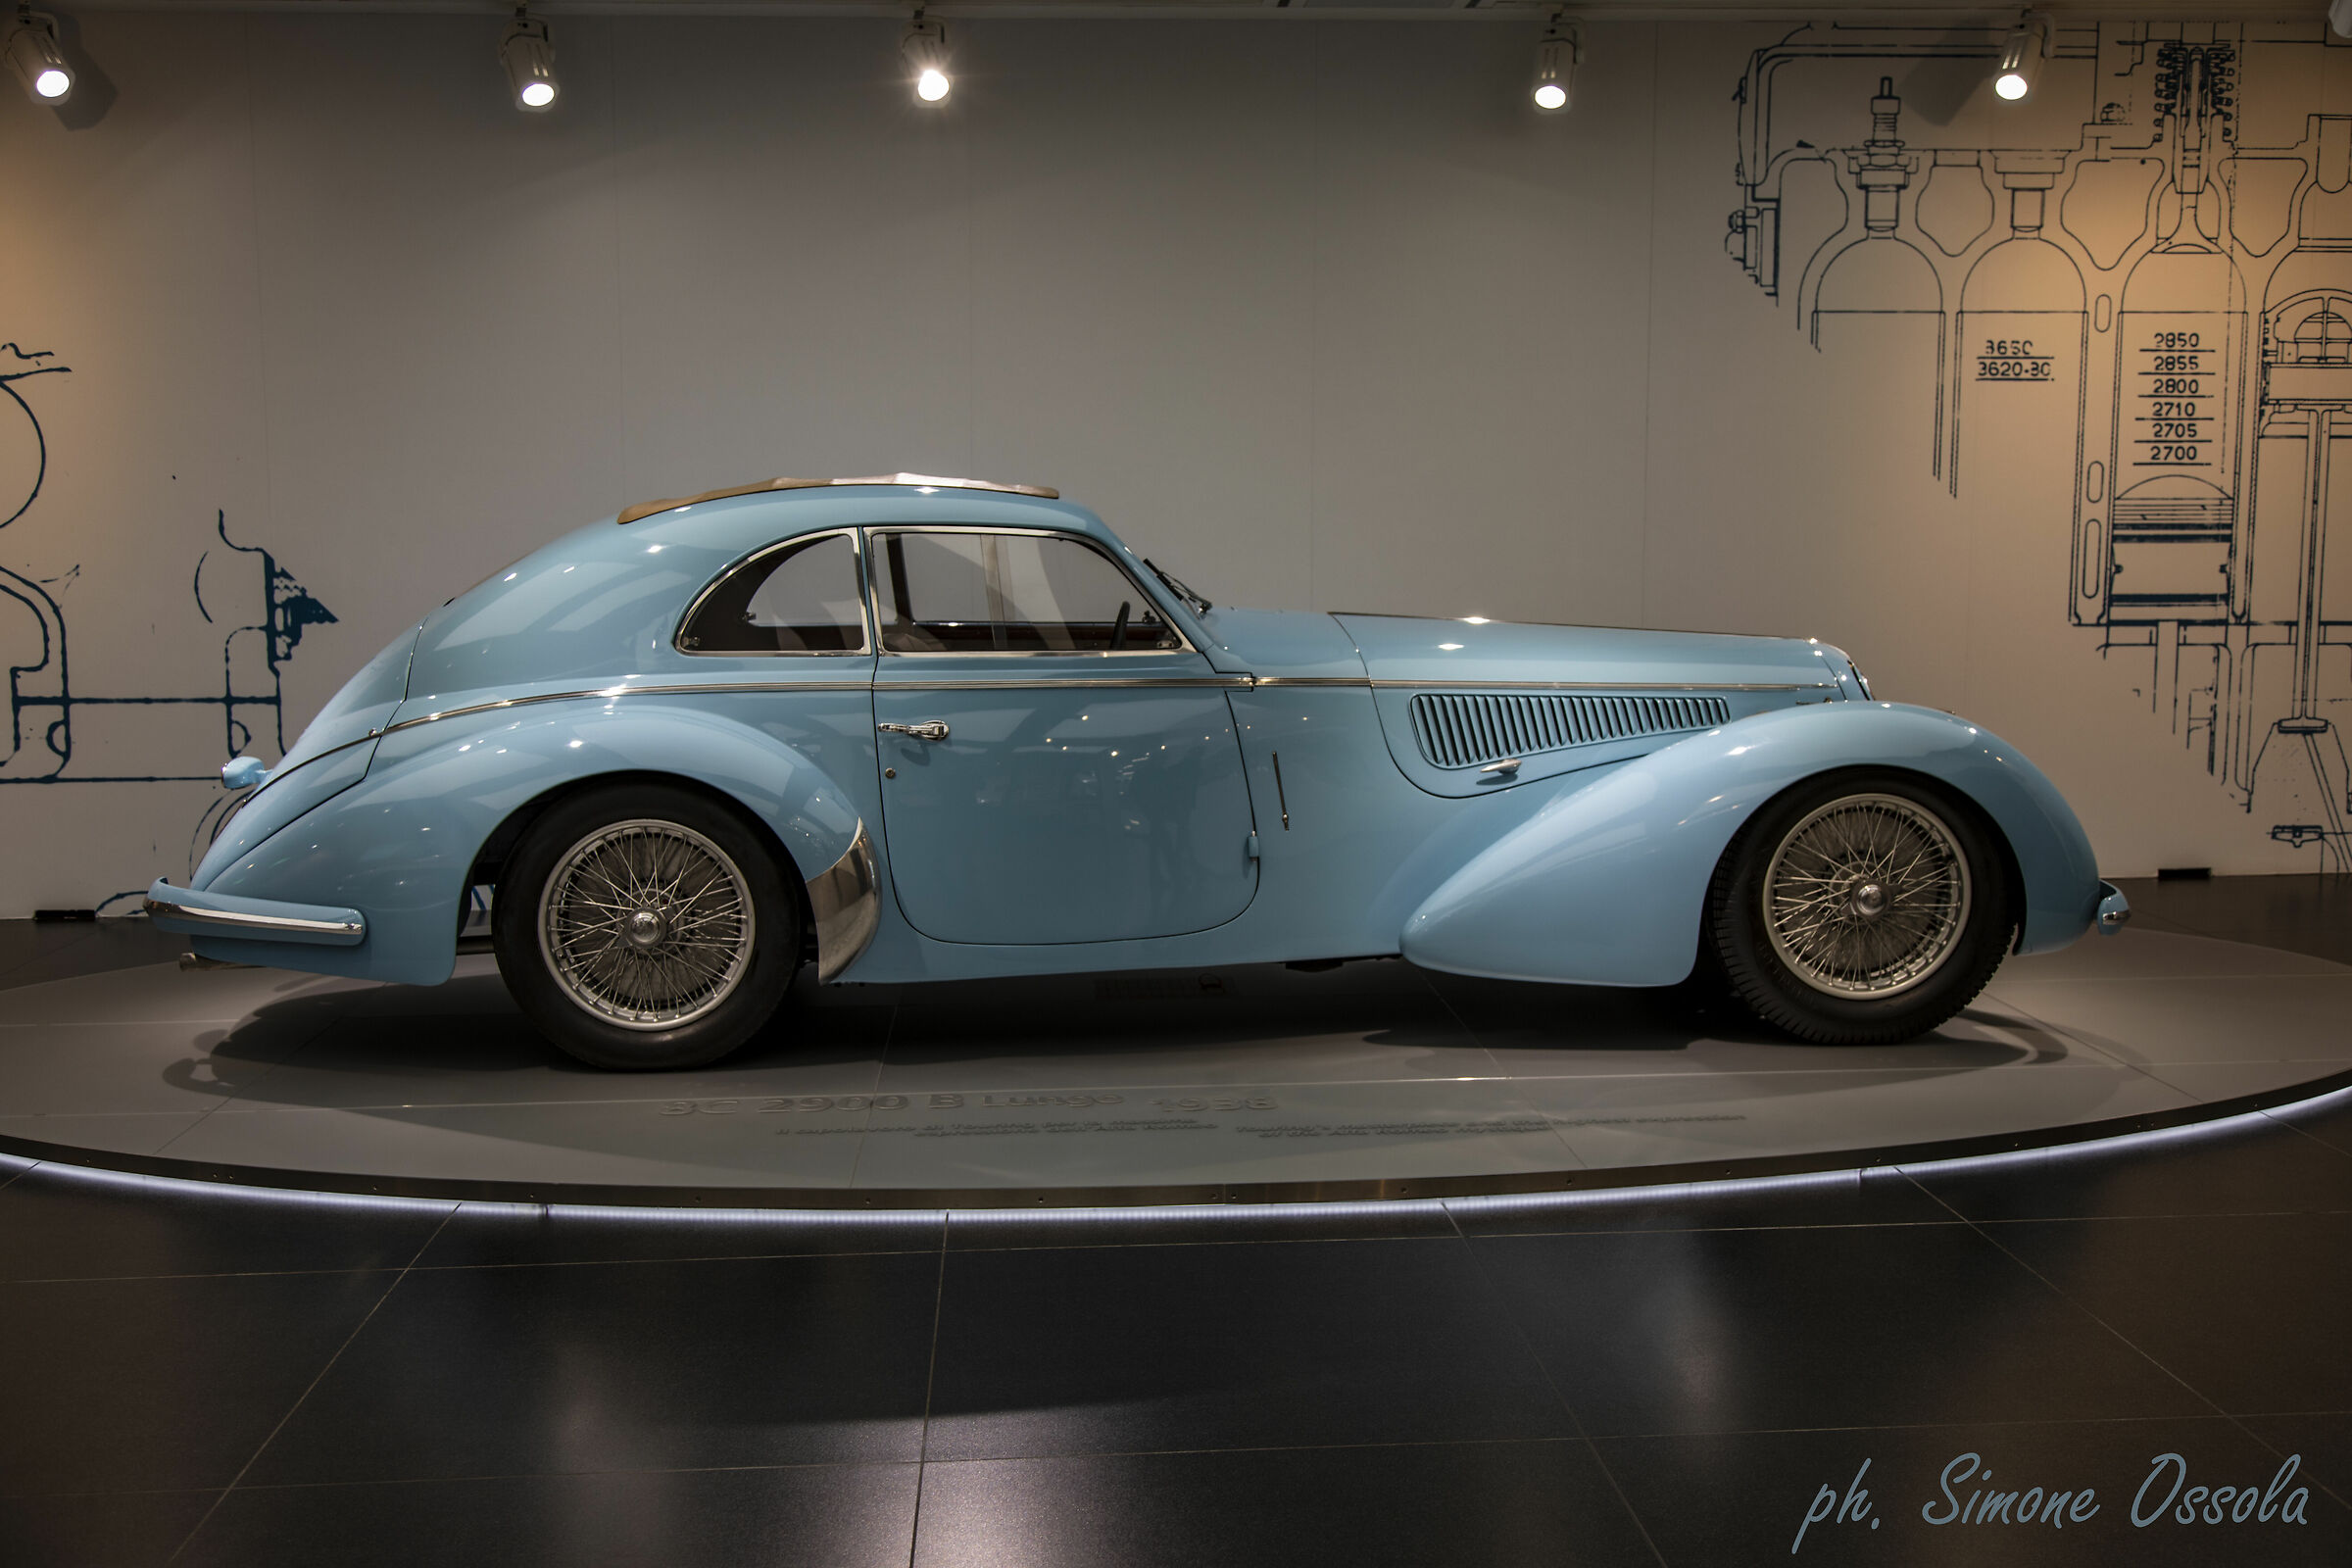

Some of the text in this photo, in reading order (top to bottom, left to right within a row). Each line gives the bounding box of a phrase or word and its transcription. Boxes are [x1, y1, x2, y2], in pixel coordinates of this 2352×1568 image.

[2153, 332, 2199, 348] 2850
[2153, 356, 2199, 371] 2855
[2153, 378, 2199, 394] 2800
[2152, 402, 2196, 417] 2710
[2152, 422, 2197, 438] 2705
[2150, 445, 2197, 461] 2700
[758, 1095, 909, 1113] 2900
[927, 1093, 964, 1109] B
[982, 1094, 1126, 1108] Lungo
